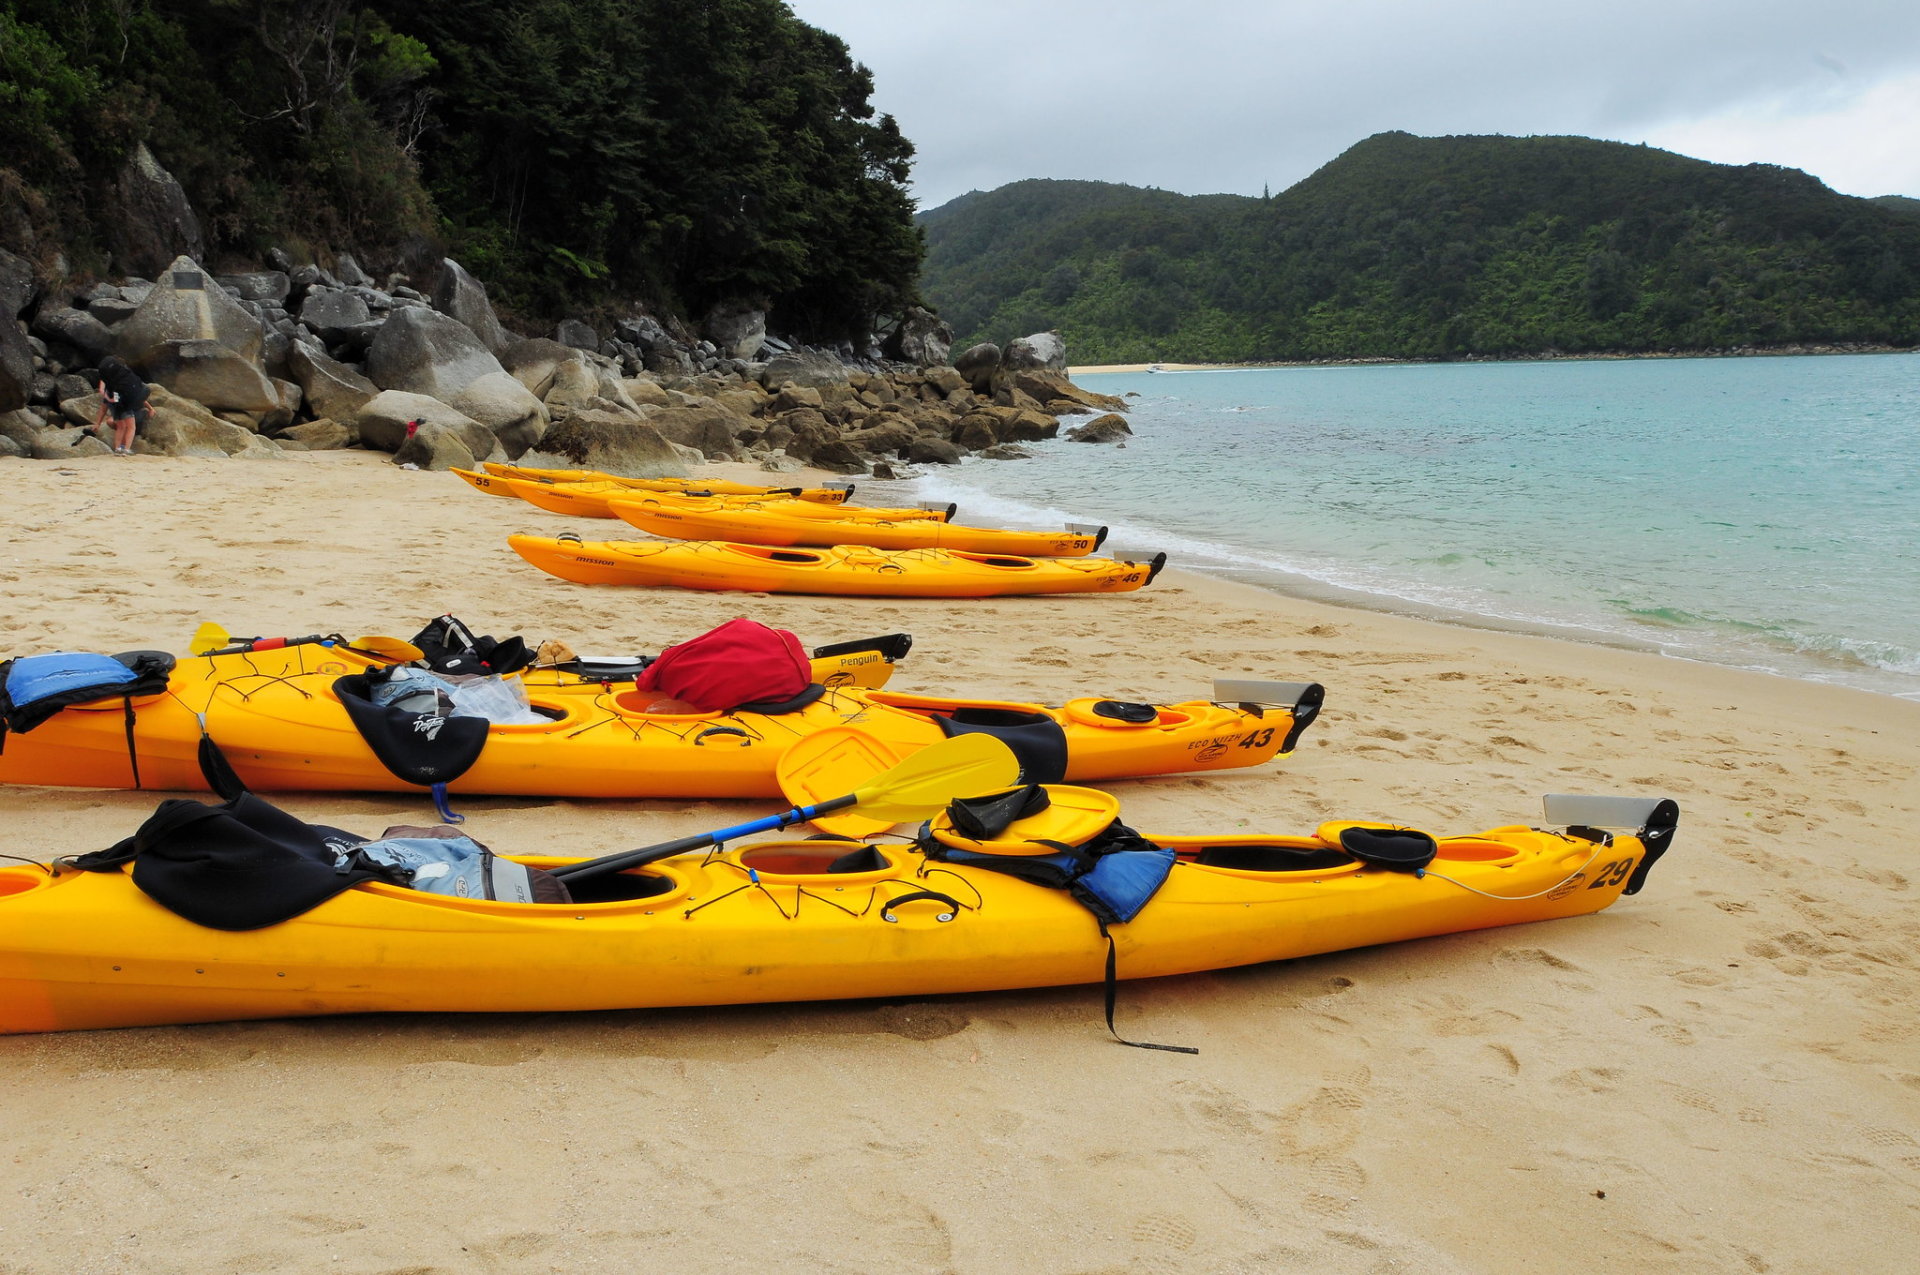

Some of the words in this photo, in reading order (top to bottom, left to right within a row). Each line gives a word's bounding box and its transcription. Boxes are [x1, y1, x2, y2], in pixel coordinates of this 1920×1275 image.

[475, 477, 490, 487] 55
[831, 493, 843, 501] 33
[654, 512, 682, 521] mission
[1072, 539, 1088, 549] 50
[575, 556, 615, 567] mission
[1122, 572, 1141, 583] 46
[840, 654, 879, 667] Penguin
[1187, 739, 1209, 750] ECO
[1238, 727, 1275, 749] 43
[1587, 858, 1634, 890] 29
